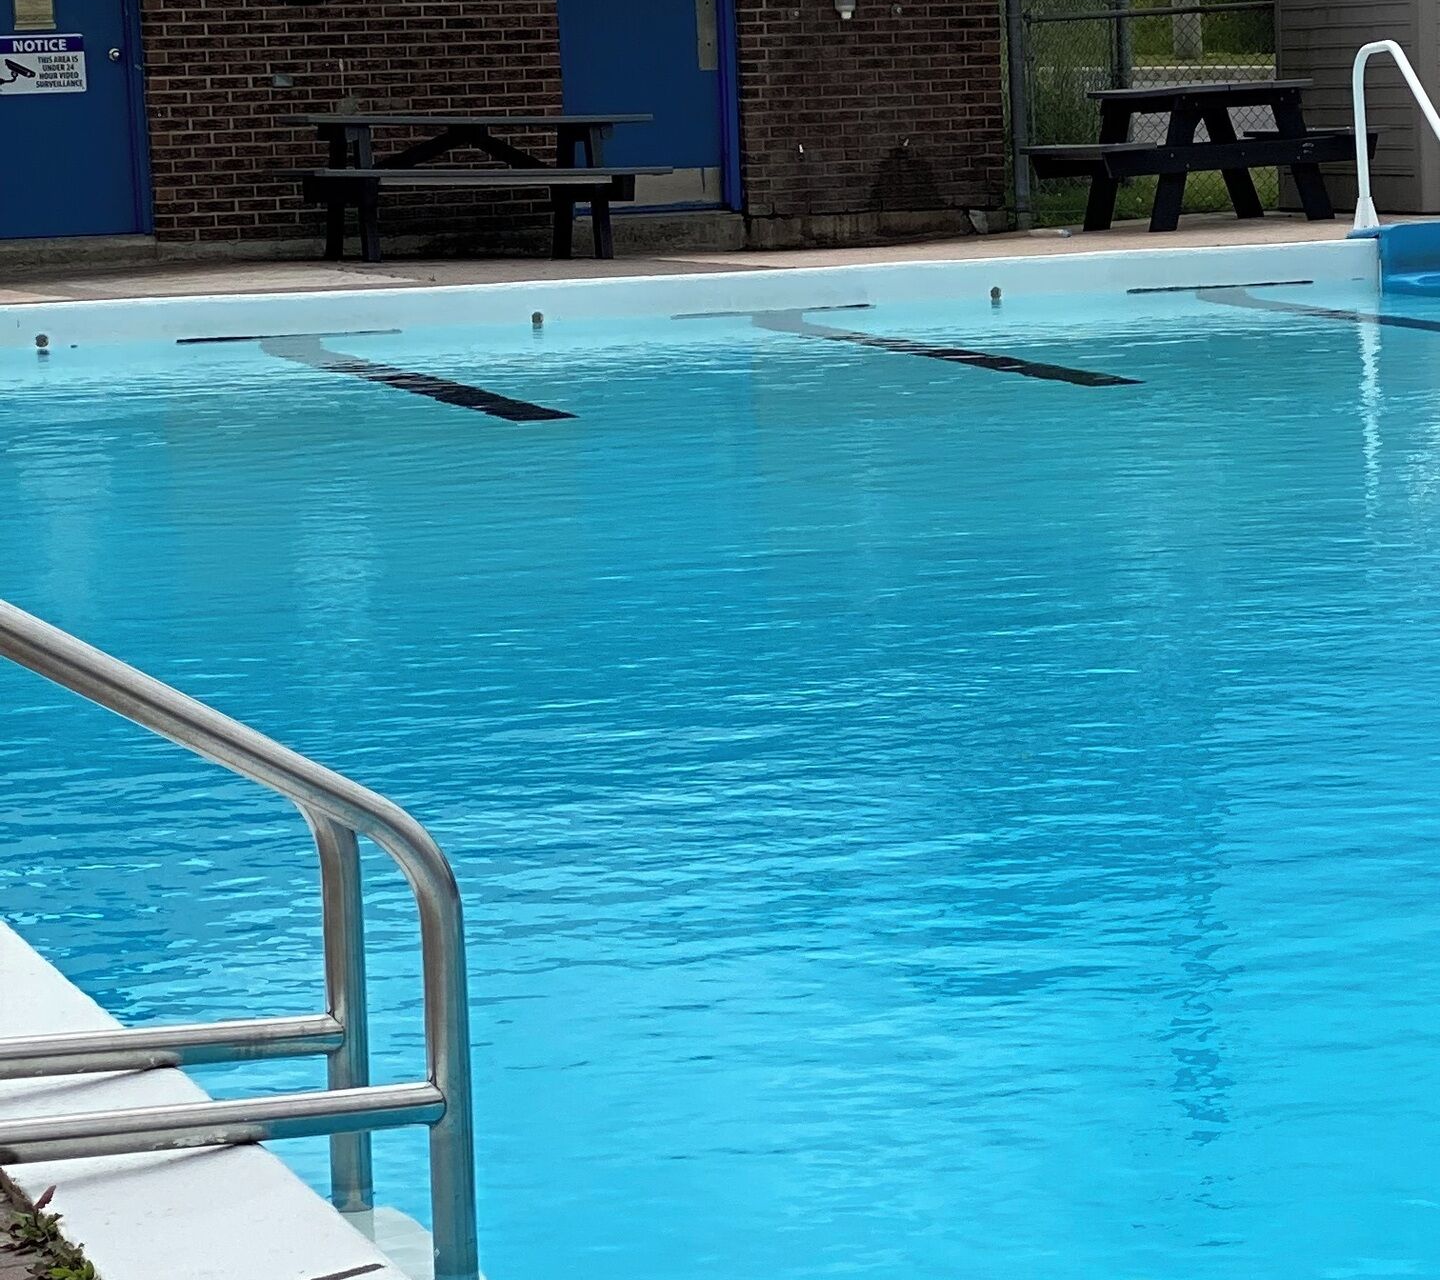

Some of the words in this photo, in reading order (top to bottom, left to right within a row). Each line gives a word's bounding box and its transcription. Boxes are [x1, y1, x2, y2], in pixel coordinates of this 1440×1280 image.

[12, 38, 67, 53] NOTICE
[37, 55, 53, 63] THIS
[54, 55, 71, 63] AREA
[66, 63, 74, 71] 24
[59, 71, 79, 79] VIDEO
[36, 79, 83, 88] SURVEILLANCE
